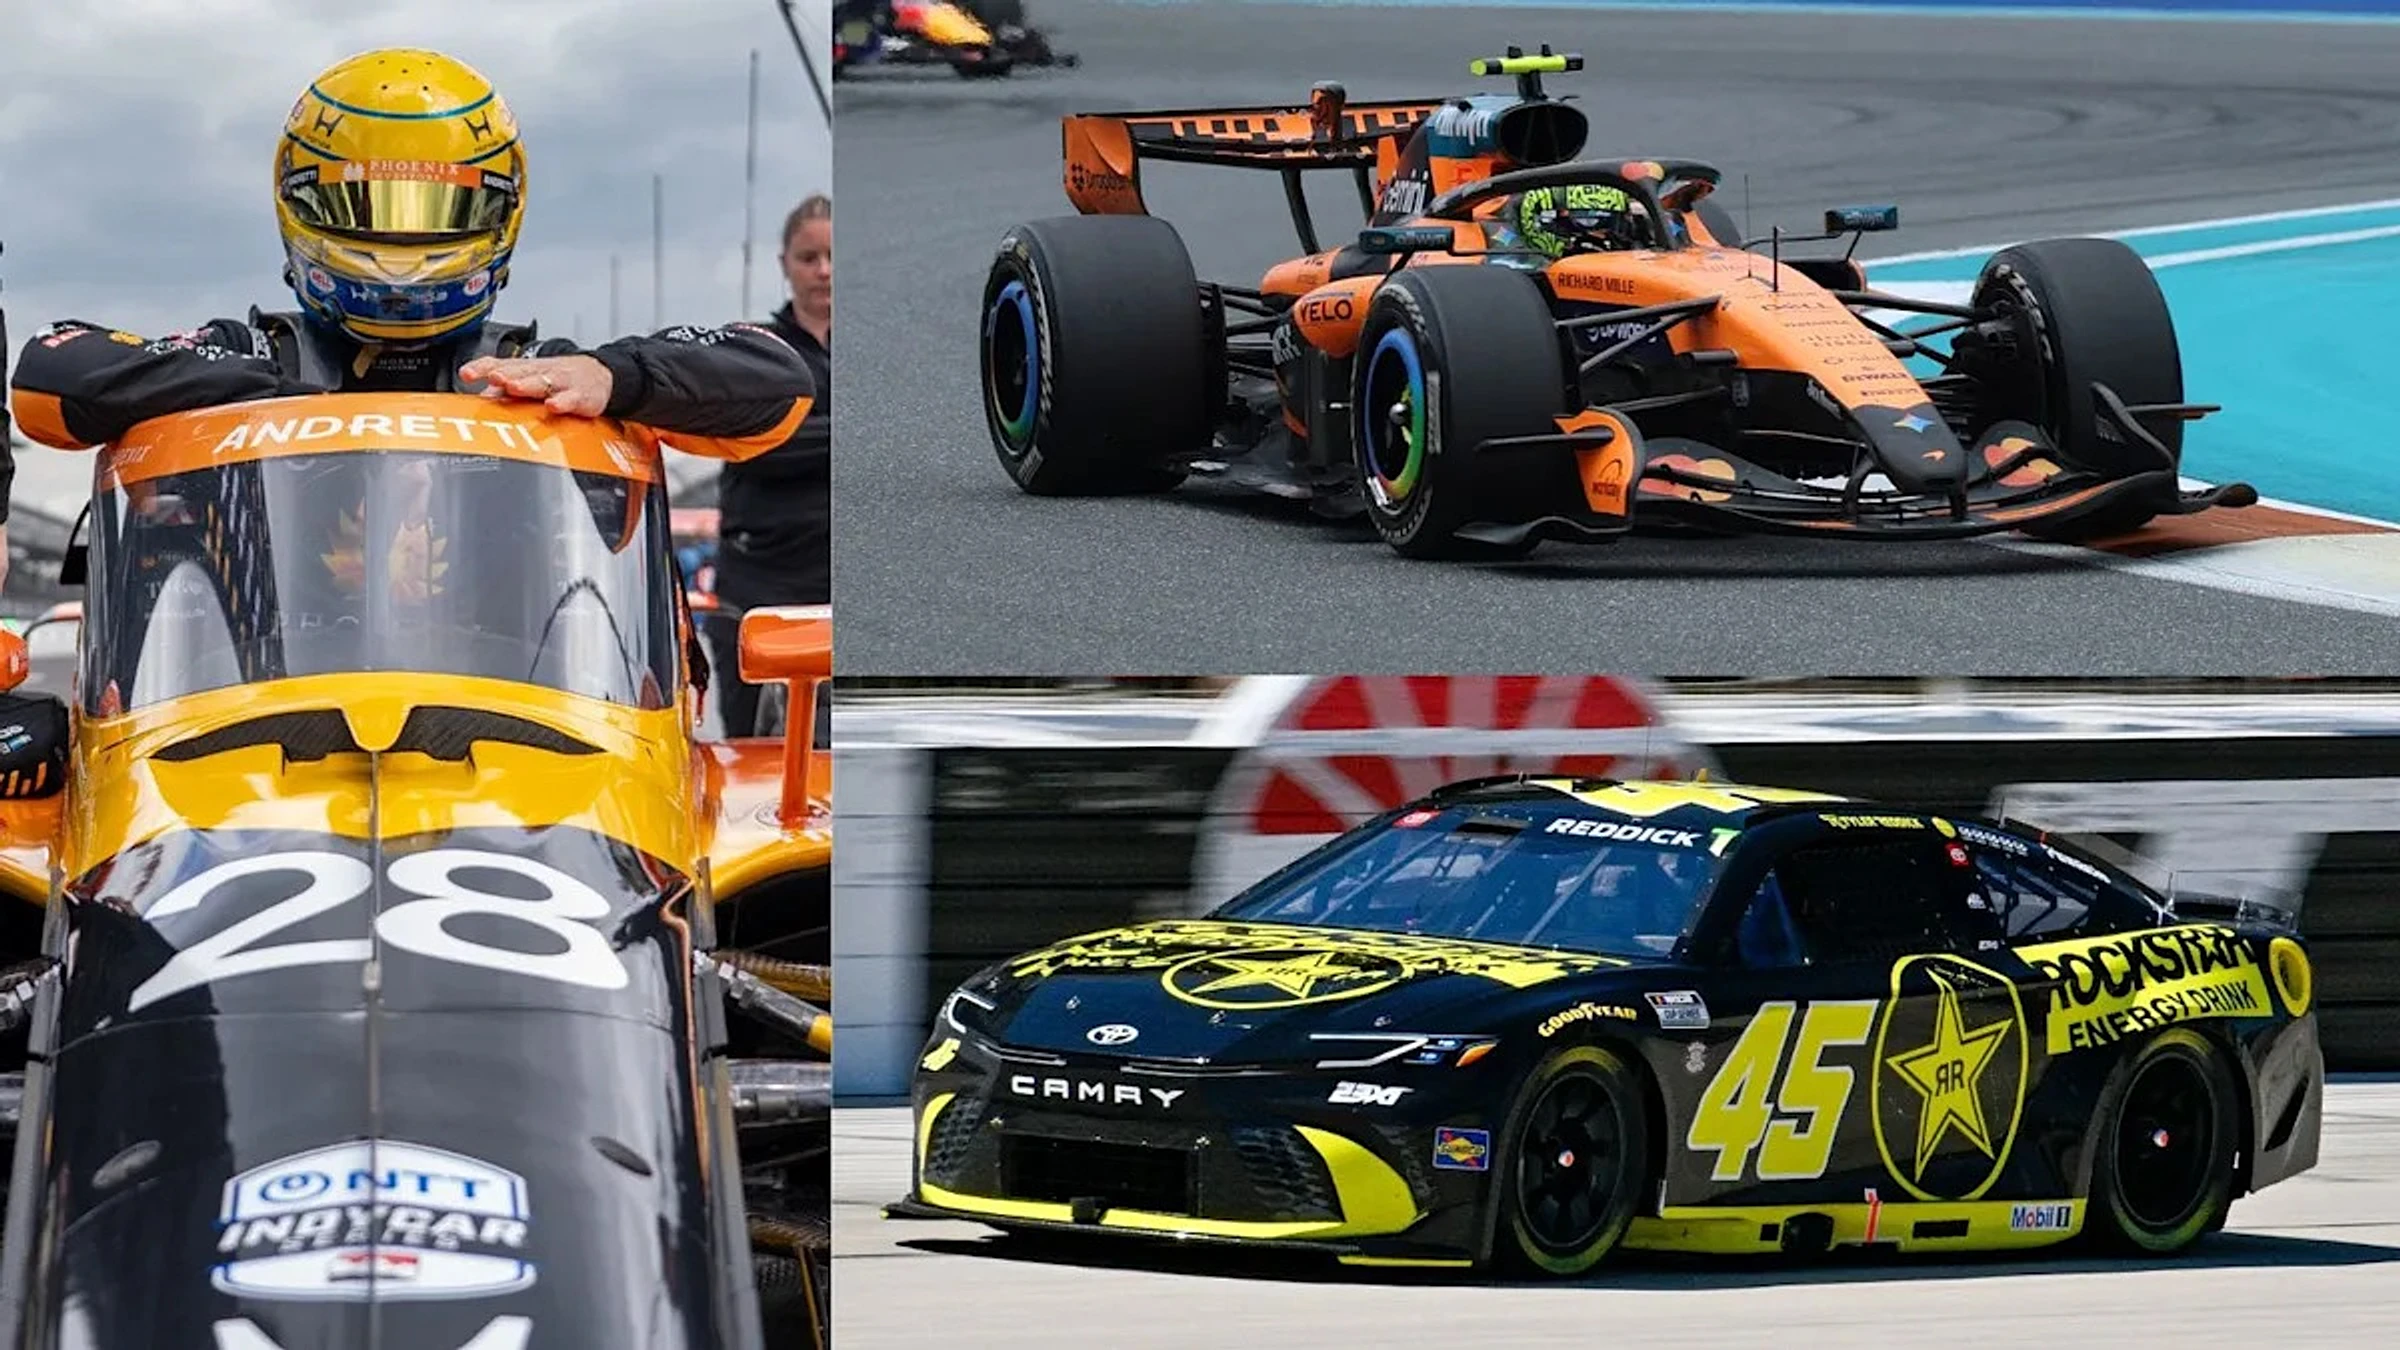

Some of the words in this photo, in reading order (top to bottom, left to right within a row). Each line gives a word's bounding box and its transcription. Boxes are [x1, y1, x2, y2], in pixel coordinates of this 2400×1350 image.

[369, 160, 459, 175] PHOENIX
[1558, 272, 1603, 291] RICHARD
[1606, 278, 1634, 295] MILLE
[1300, 299, 1353, 323] VELO
[212, 412, 541, 454] ANDRETTI
[1544, 817, 1703, 848] REDDICK
[129, 848, 630, 1013] 28
[1538, 1002, 1637, 1038] GOODYEAR
[2068, 988, 2191, 1050] ENERGY
[2191, 980, 2259, 1014] DRINK
[1011, 1074, 1185, 1109] CAMRY
[1687, 999, 1880, 1181] 45
[346, 1164, 492, 1199] NTT
[216, 1202, 530, 1253] INDYCAR
[2011, 1205, 2056, 1228] Mobil
